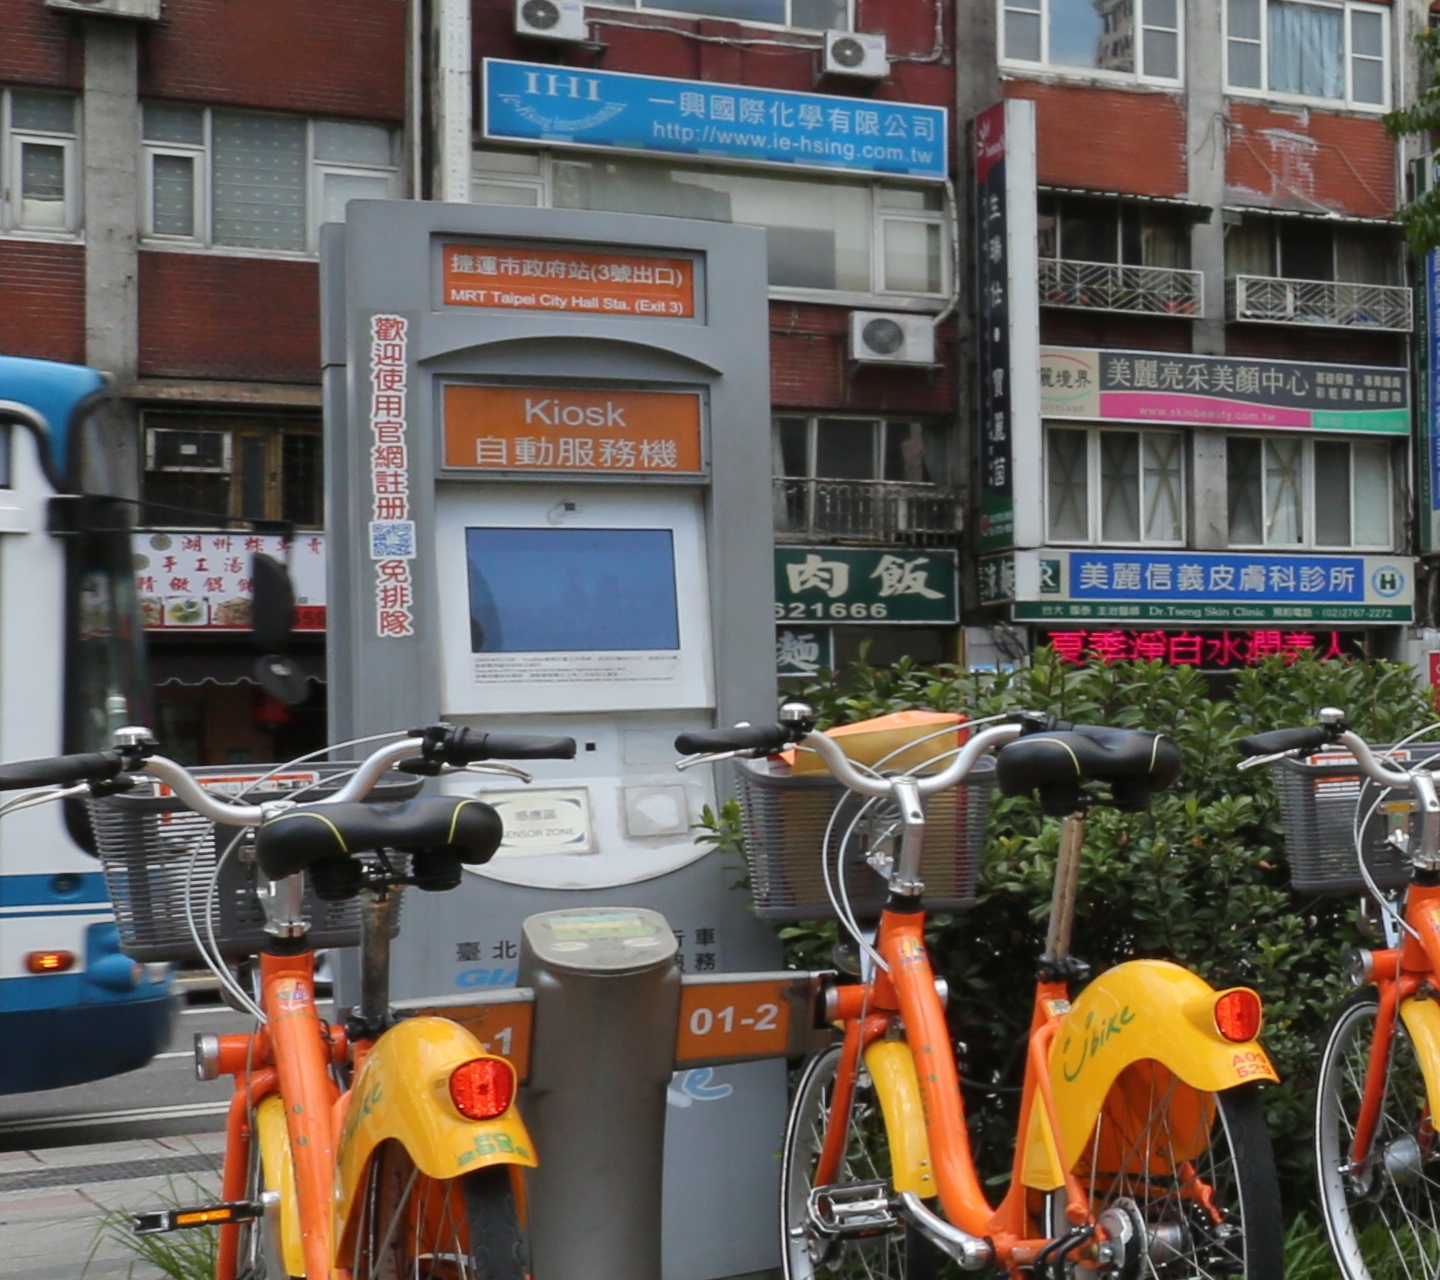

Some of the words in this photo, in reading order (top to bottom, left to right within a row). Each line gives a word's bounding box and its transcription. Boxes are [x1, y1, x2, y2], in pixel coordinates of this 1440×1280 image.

[525, 71, 602, 101] IHI
[648, 92, 935, 142] 一興國際化學有限公司
[653, 120, 933, 163] http://www.ie-hsing.com.tw
[451, 253, 683, 287] 捷運市政府站(3號出口)
[451, 288, 485, 303] MRT
[492, 290, 535, 307] Taipei
[540, 292, 567, 309] City
[571, 294, 598, 309] Hall
[603, 296, 630, 310] Sta.
[634, 297, 667, 314] (Exit
[669, 300, 684, 316] 3)
[1107, 358, 1310, 397] 美麗亮采美顏中心
[525, 398, 627, 427] Kiosk
[475, 436, 678, 469] 自動服務機
[1079, 561, 1356, 593] 美麗信義皮膚科診所
[378, 559, 413, 636] 免排隊
[1204, 606, 1229, 617] Skin
[1232, 607, 1266, 618] Clinic
[545, 827, 575, 837] ZONE
[689, 1003, 779, 1036] 01-2
